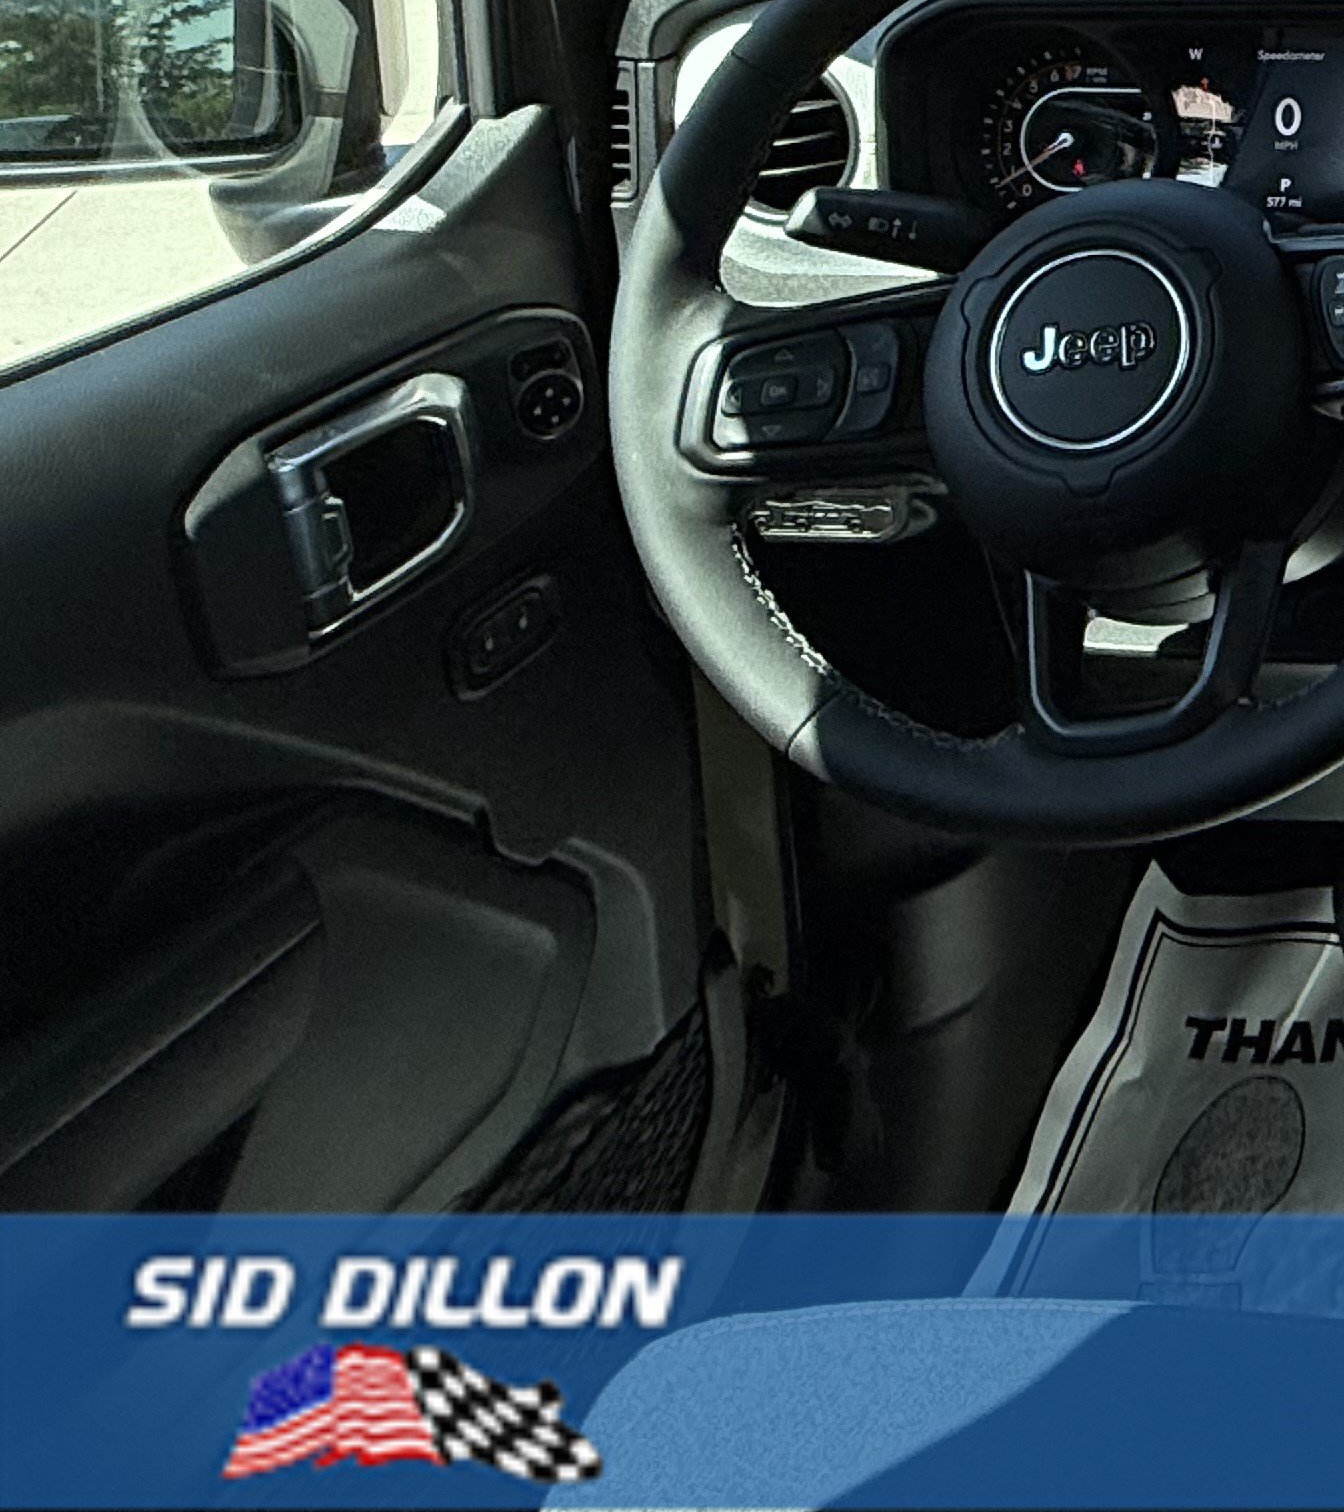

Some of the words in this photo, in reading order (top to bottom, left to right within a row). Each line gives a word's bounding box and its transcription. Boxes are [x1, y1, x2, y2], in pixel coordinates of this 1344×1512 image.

[1189, 47, 1204, 61] W
[1274, 96, 1302, 136] 0
[1279, 178, 1292, 192] P
[1022, 324, 1157, 373] Jeep
